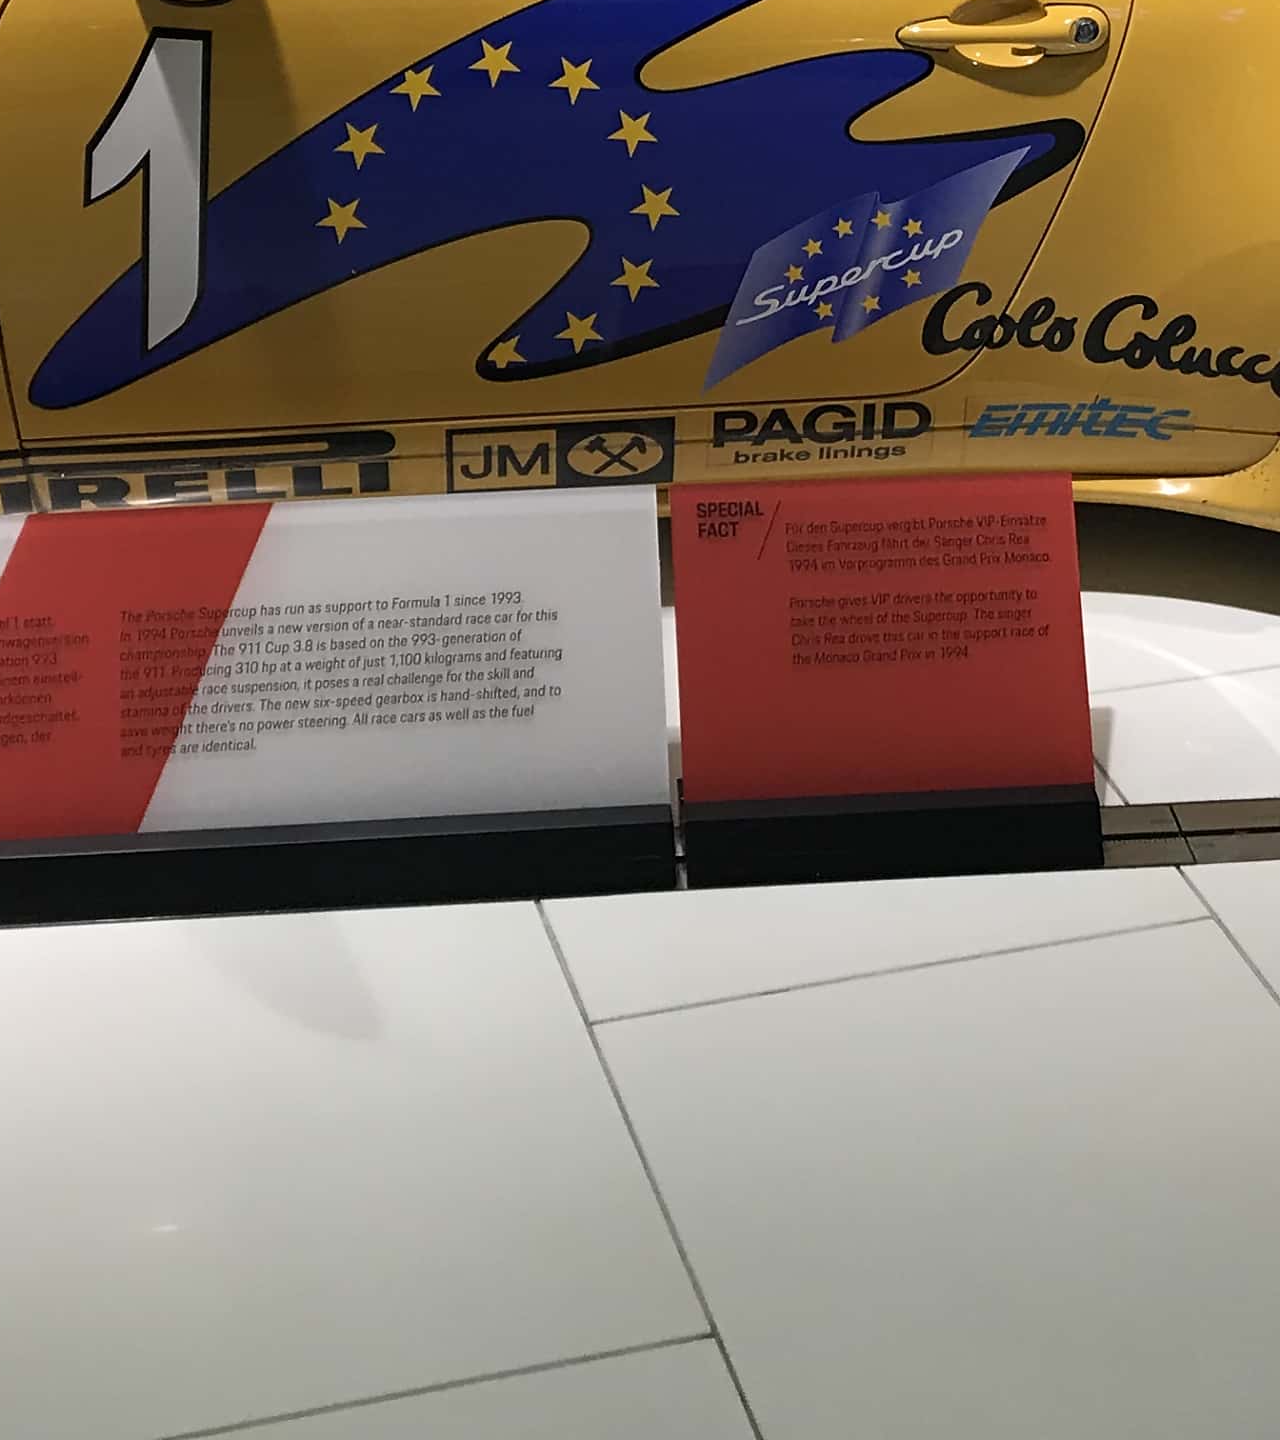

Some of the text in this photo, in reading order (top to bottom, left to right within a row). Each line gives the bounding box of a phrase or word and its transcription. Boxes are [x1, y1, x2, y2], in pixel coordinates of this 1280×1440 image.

[83, 26, 213, 352] 1
[734, 227, 965, 328] Supercup
[713, 400, 933, 449] PAGID
[458, 438, 553, 481] JM
[733, 442, 907, 465] brake linings
[696, 500, 765, 520] SPECIAL
[697, 520, 740, 540] FACT
